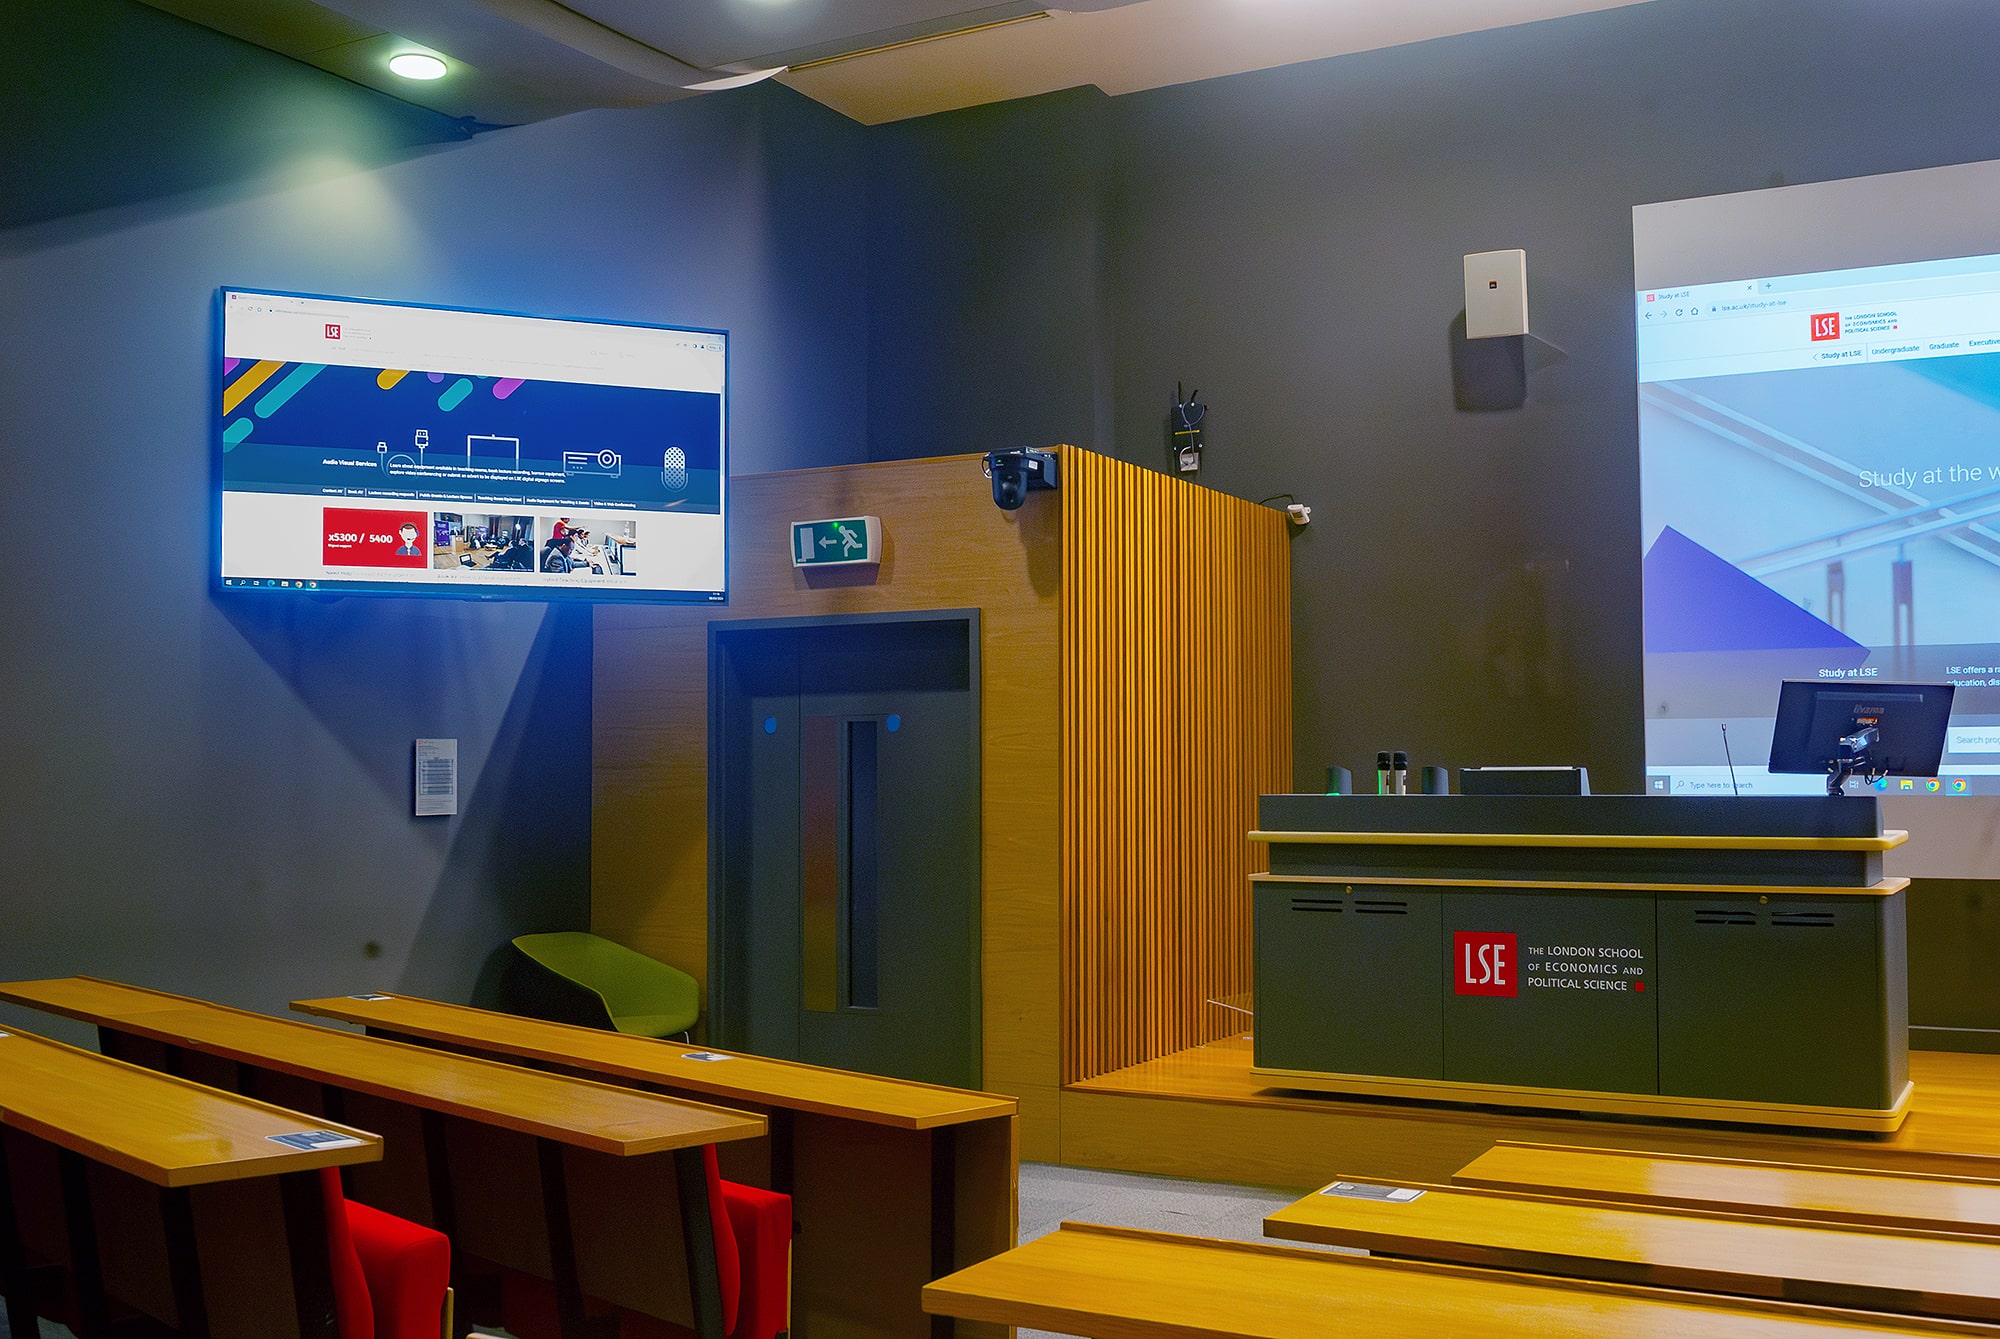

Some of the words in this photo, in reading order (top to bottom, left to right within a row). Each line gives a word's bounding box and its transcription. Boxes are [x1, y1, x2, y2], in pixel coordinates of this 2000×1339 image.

[327, 326, 339, 338] LSE
[1815, 317, 1836, 337] LSE
[1872, 346, 1920, 355] Undergraduate
[1929, 342, 1960, 350] Graduate
[1859, 467, 1917, 490] Study
[1923, 467, 1943, 484] at
[1948, 464, 1981, 482] the
[328, 533, 357, 542] x5300
[358, 533, 365, 543] /
[369, 534, 393, 544] 5400
[1818, 668, 1846, 680] Study
[1847, 668, 1858, 677] at
[1860, 668, 1878, 676] LSE
[1690, 781, 1705, 789] Type
[1528, 946, 1544, 955] THE
[1547, 946, 1595, 957] LONDON
[1598, 948, 1644, 959] SCHOOL
[1465, 943, 1506, 985] LSE
[1545, 962, 1618, 975] ECONOMICS
[1622, 967, 1644, 975] AND
[1527, 977, 1580, 989] POLITICAL
[1584, 980, 1627, 991] SCIENCE
